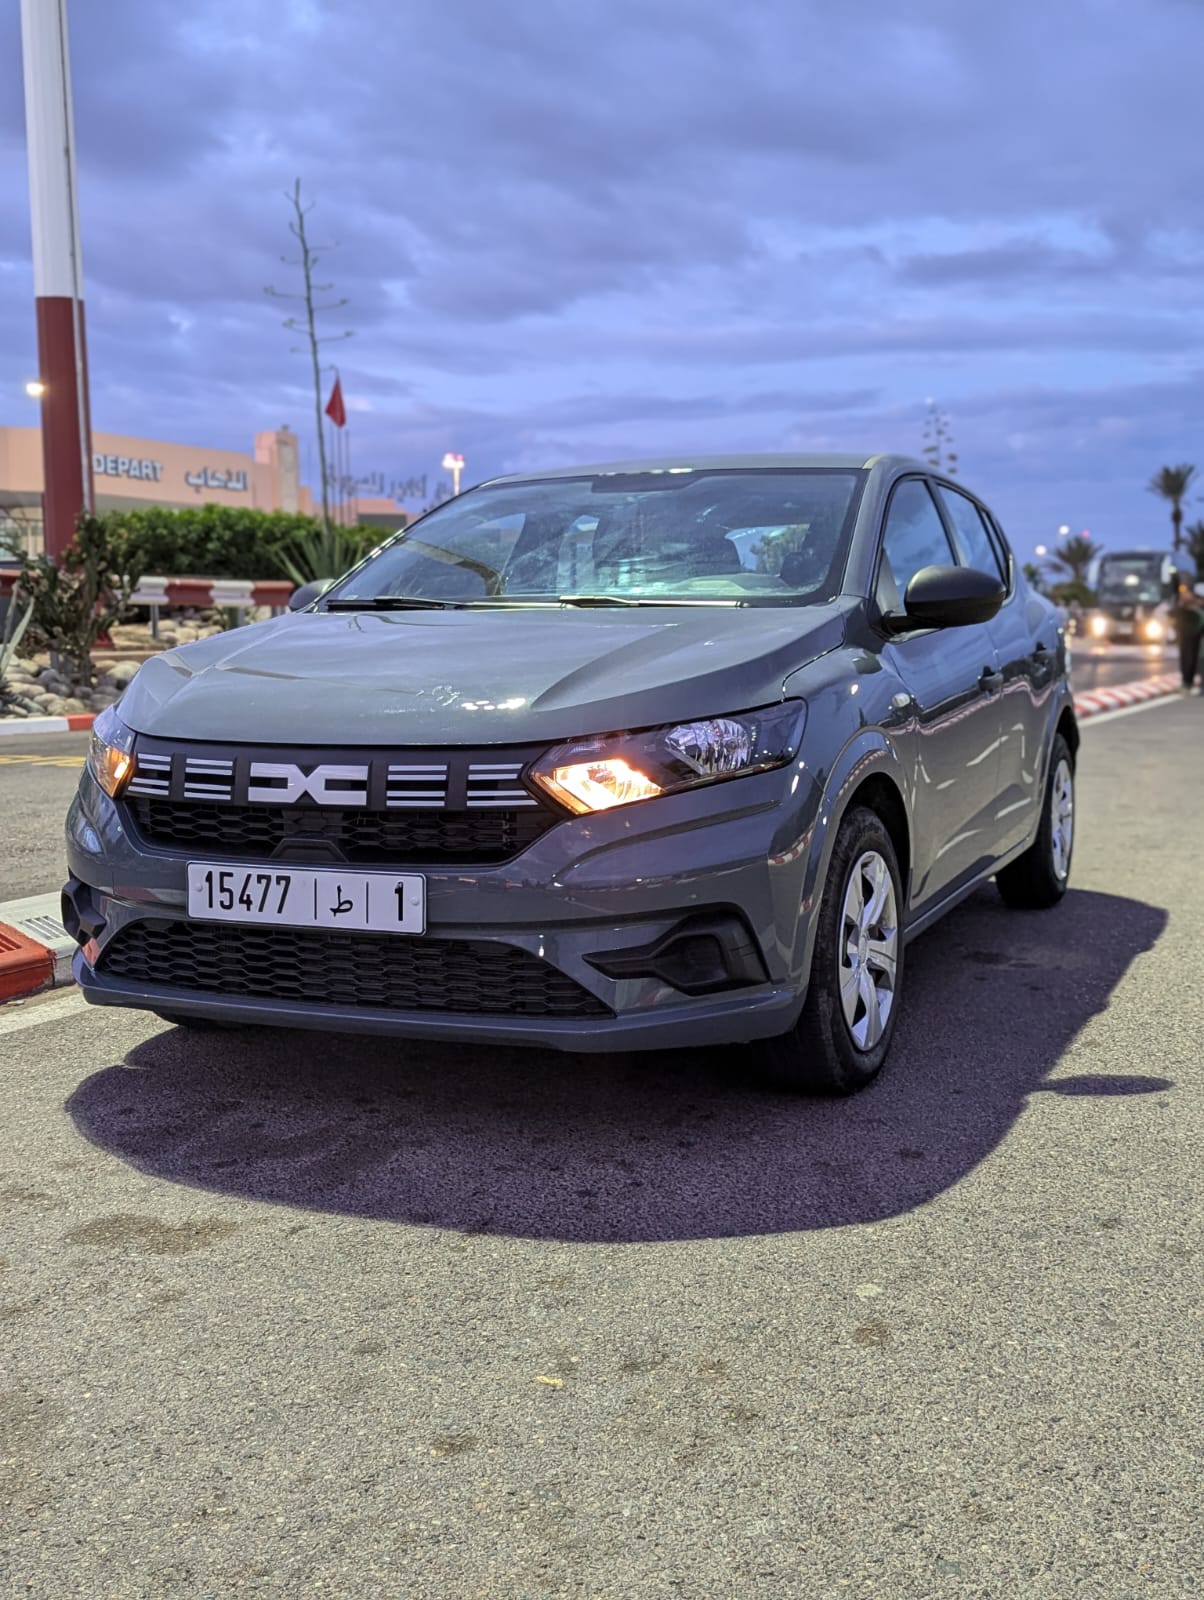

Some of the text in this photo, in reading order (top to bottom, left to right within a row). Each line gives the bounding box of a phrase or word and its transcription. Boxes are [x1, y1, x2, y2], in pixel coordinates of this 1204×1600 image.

[92, 454, 162, 482] DEPART
[205, 870, 291, 915] 15477
[394, 881, 404, 922] 1
